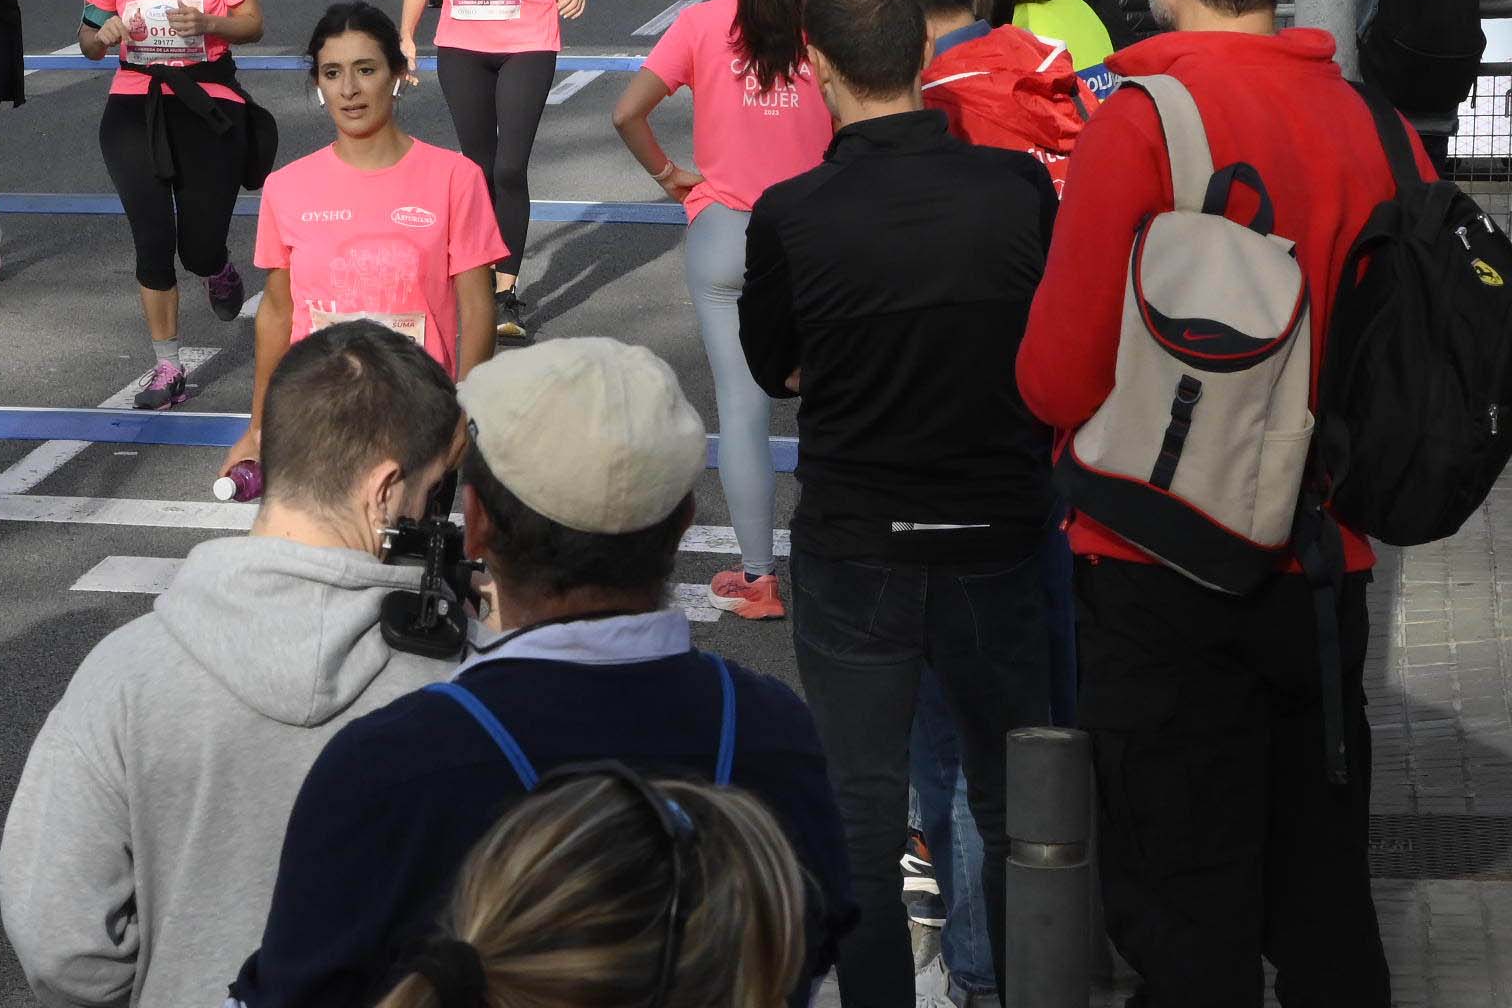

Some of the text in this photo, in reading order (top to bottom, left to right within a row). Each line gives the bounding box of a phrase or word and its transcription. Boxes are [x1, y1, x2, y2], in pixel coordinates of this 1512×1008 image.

[150, 26, 177, 37] 016
[742, 90, 799, 108] MUJER
[301, 209, 352, 222] OYSHO
[392, 321, 416, 329] SUMA
